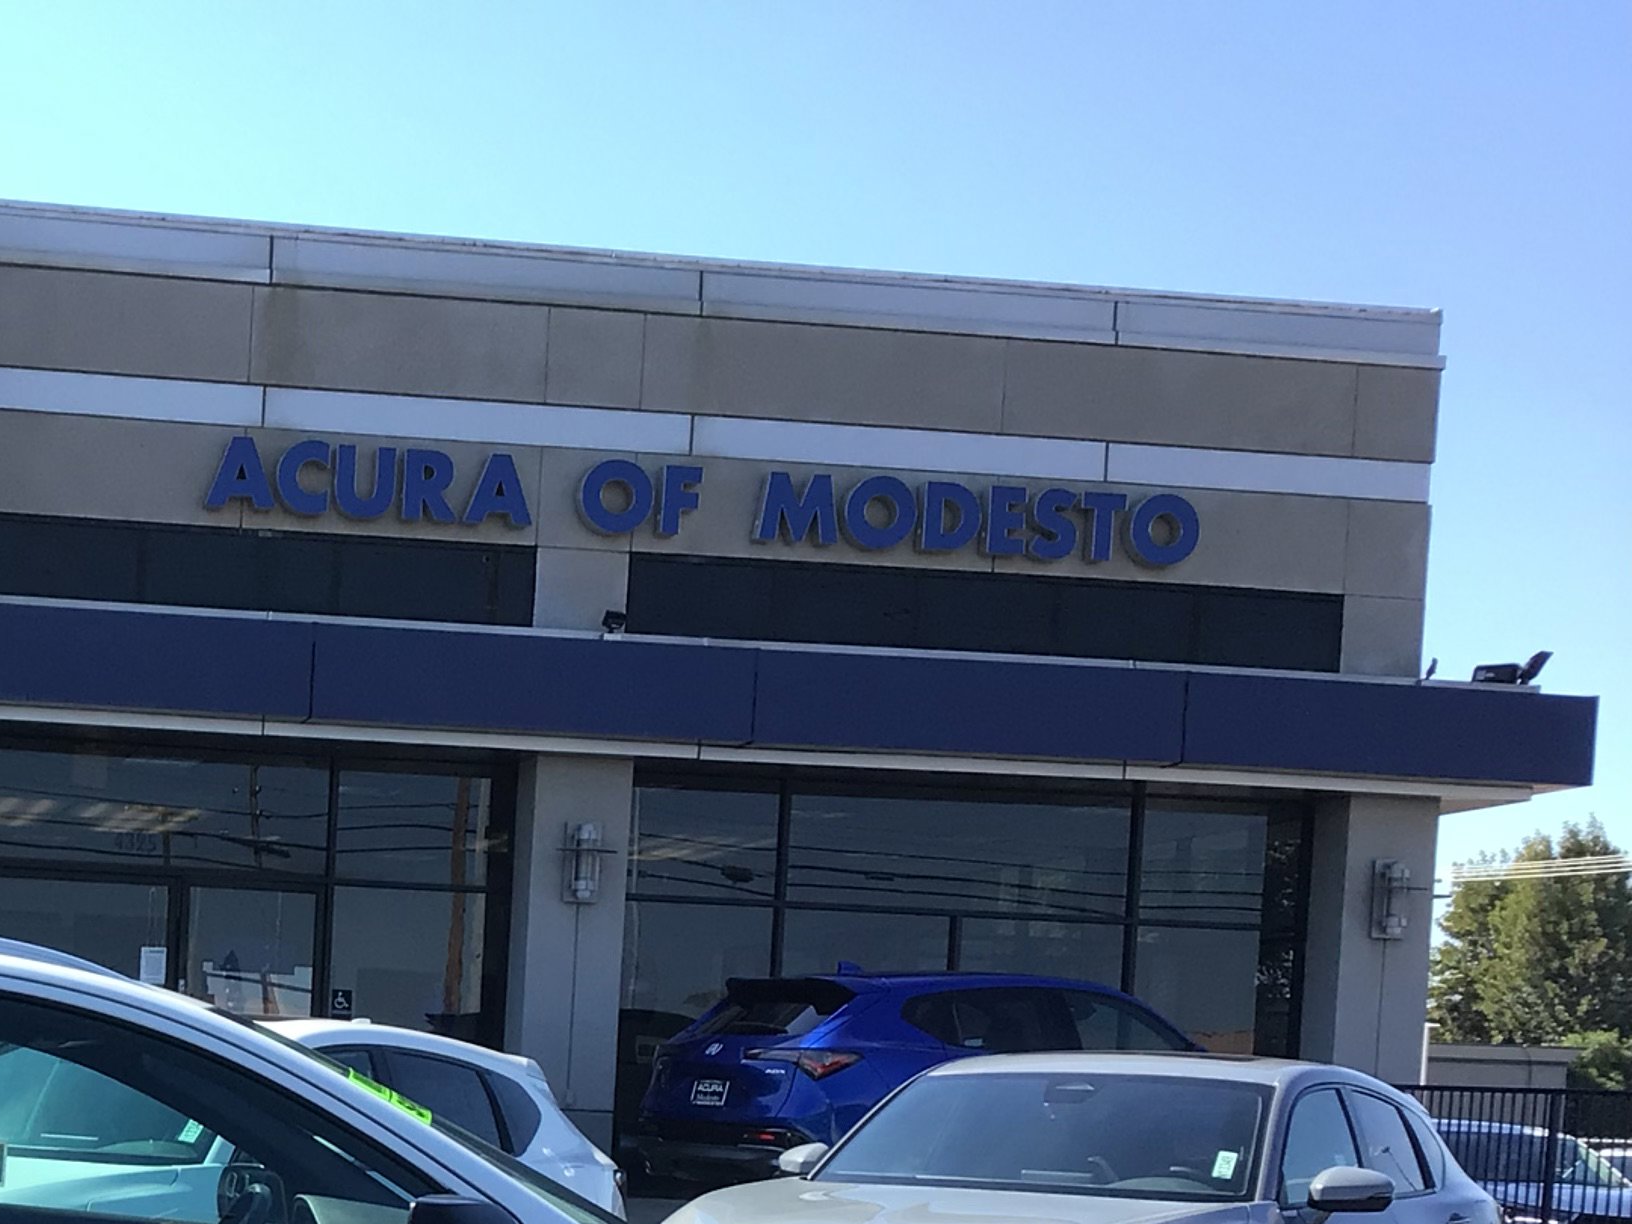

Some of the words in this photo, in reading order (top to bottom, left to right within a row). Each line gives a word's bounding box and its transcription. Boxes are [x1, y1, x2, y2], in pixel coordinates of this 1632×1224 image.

[204, 437, 532, 529] ACURA
[576, 459, 704, 537] OF
[753, 471, 1200, 567] MODESTO
